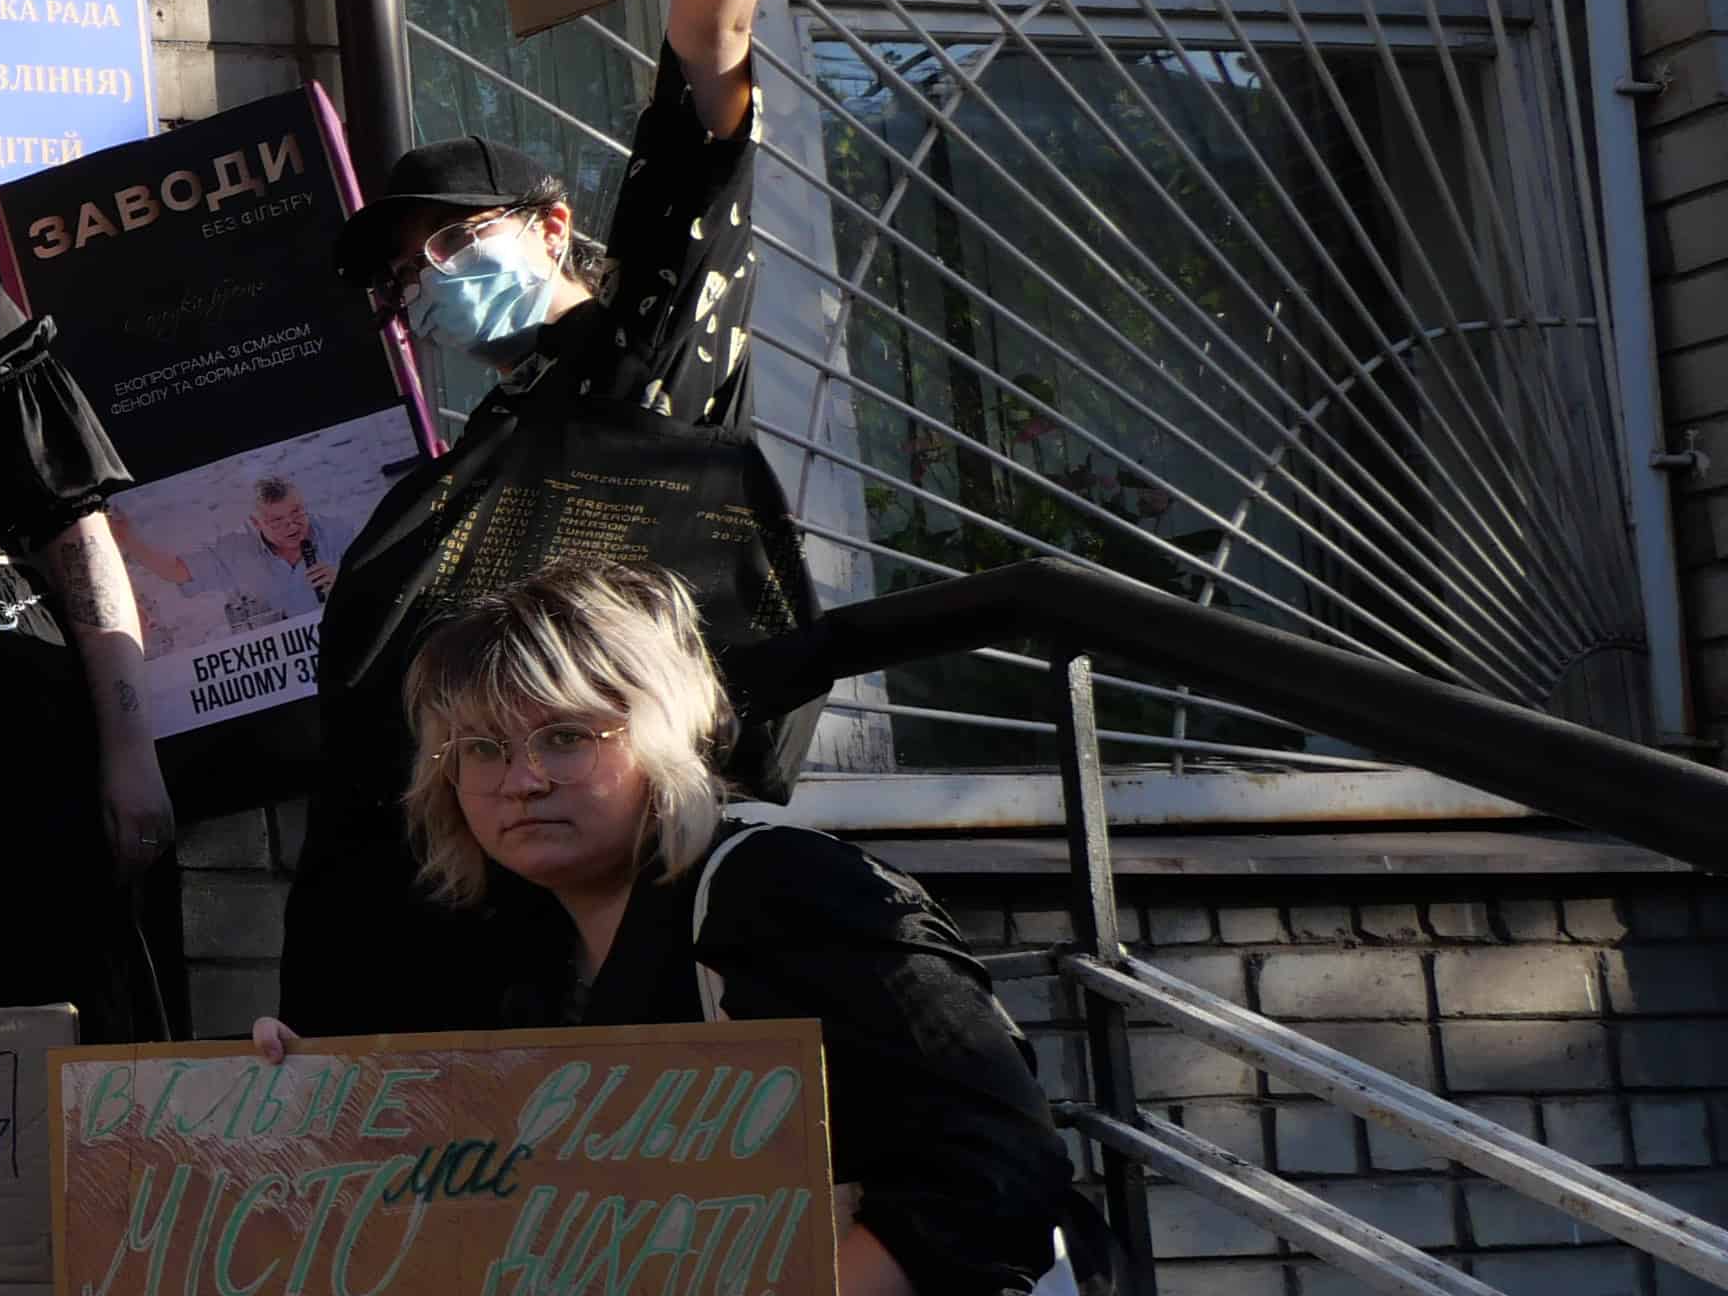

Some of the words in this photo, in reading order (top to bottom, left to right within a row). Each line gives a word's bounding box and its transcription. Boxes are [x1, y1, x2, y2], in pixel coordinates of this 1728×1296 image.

[47, 1, 121, 29] РАДА
[29, 132, 304, 259] ЗАВОДИ
[201, 220, 237, 239] БЕЗ
[240, 191, 314, 225] ФІЛЬТРУ
[114, 350, 226, 396] ЕКОПРОГРАМА
[241, 322, 312, 354] СМАКОМ
[110, 386, 169, 416] ФЕНОЛУ
[173, 379, 193, 396] ТА
[193, 636, 279, 683] БРЕХНЯ
[190, 663, 288, 714] НАШОМУ
